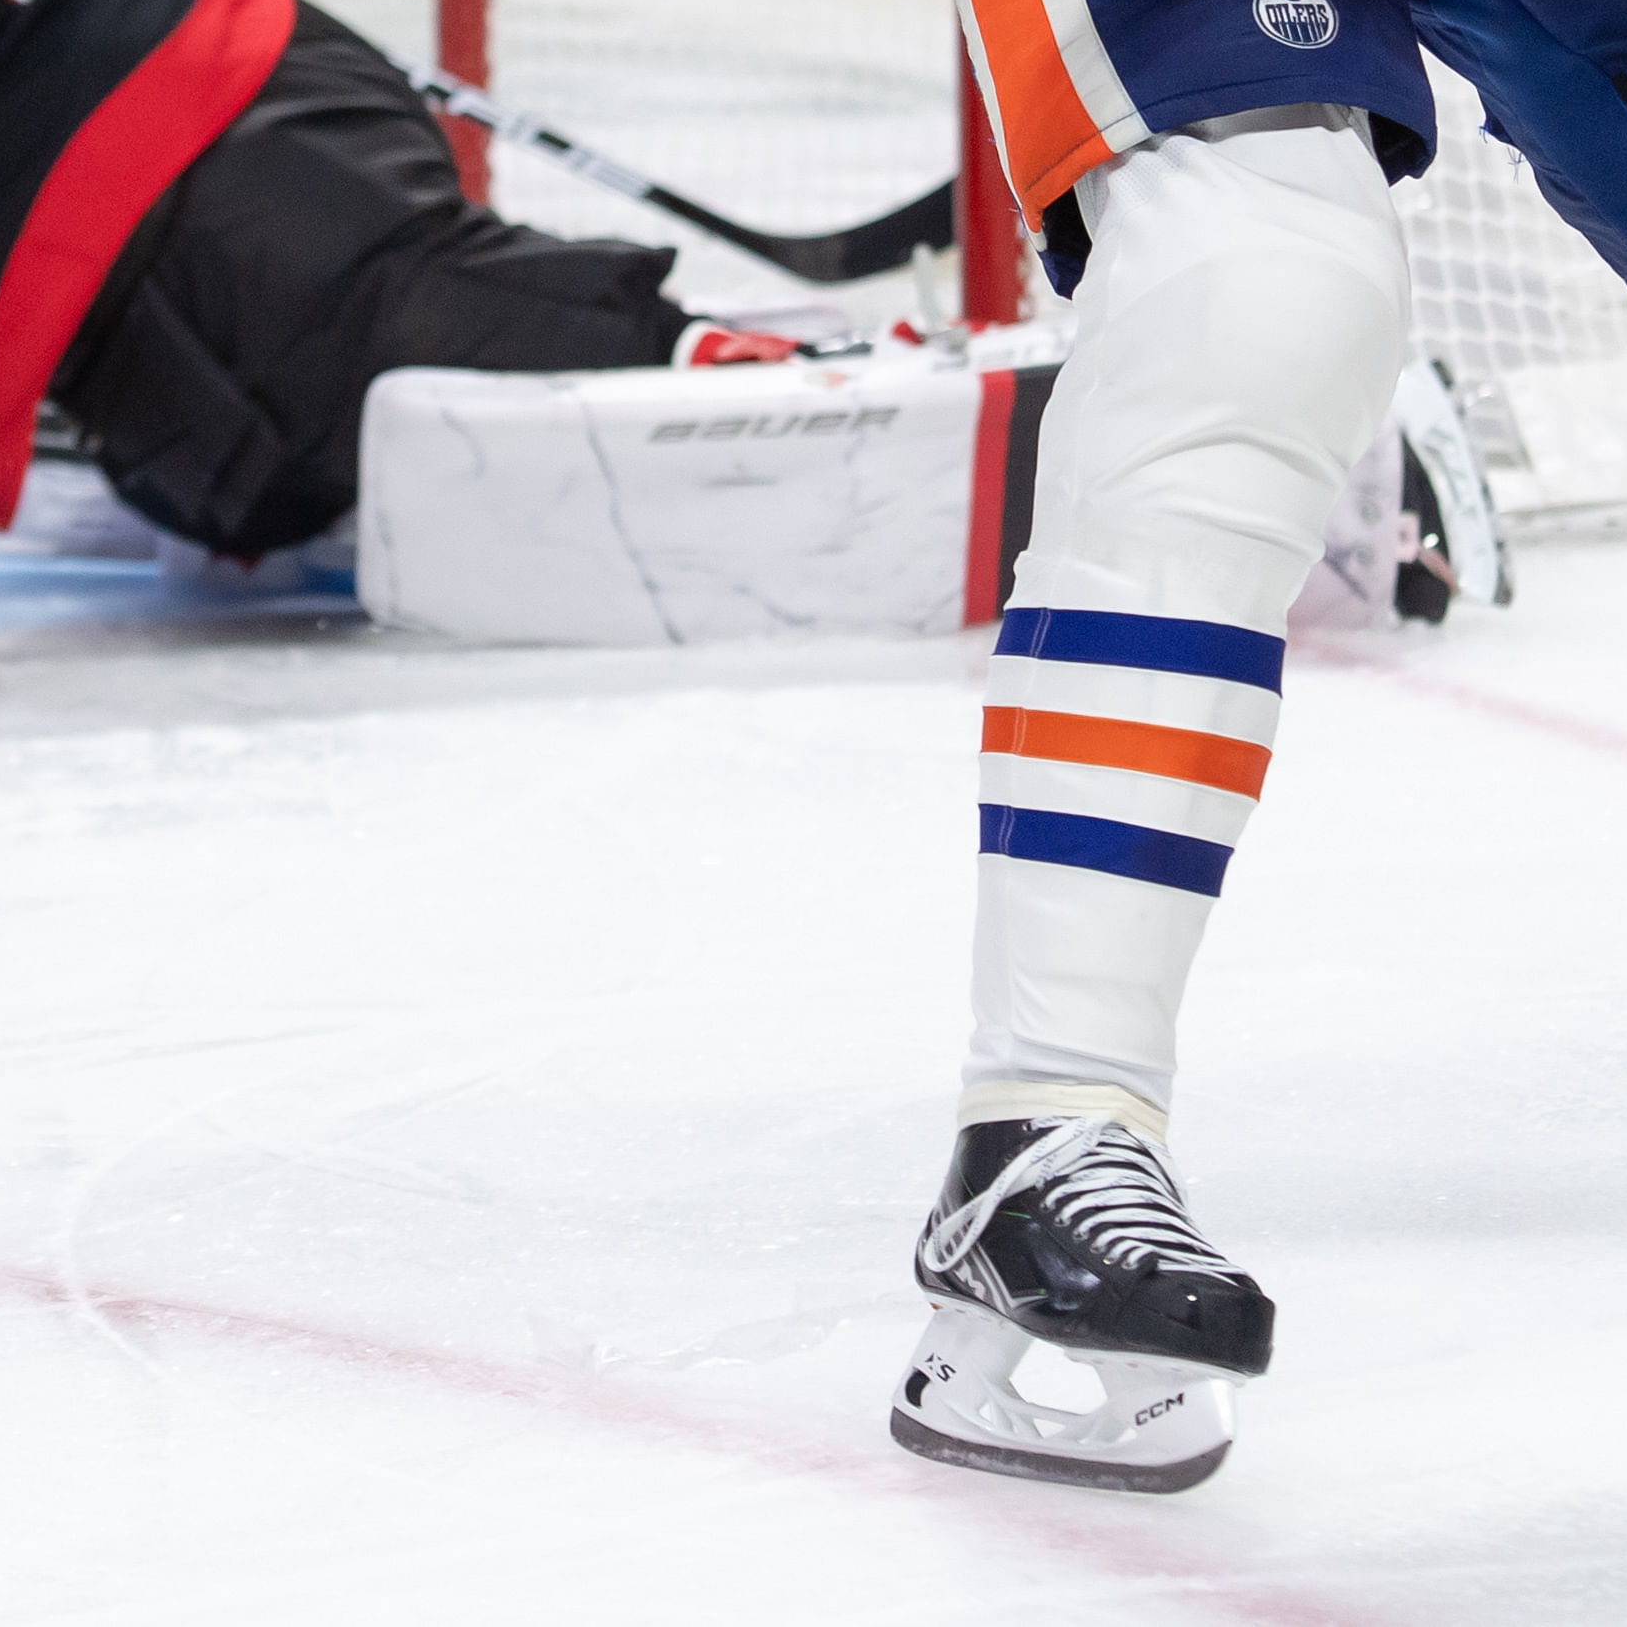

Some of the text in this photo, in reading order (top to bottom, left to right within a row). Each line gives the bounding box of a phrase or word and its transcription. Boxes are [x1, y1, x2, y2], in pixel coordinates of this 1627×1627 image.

[1265, 3, 1330, 37] OILERS
[647, 404, 901, 446] BAUER
[1135, 1391, 1185, 1426] CCM
